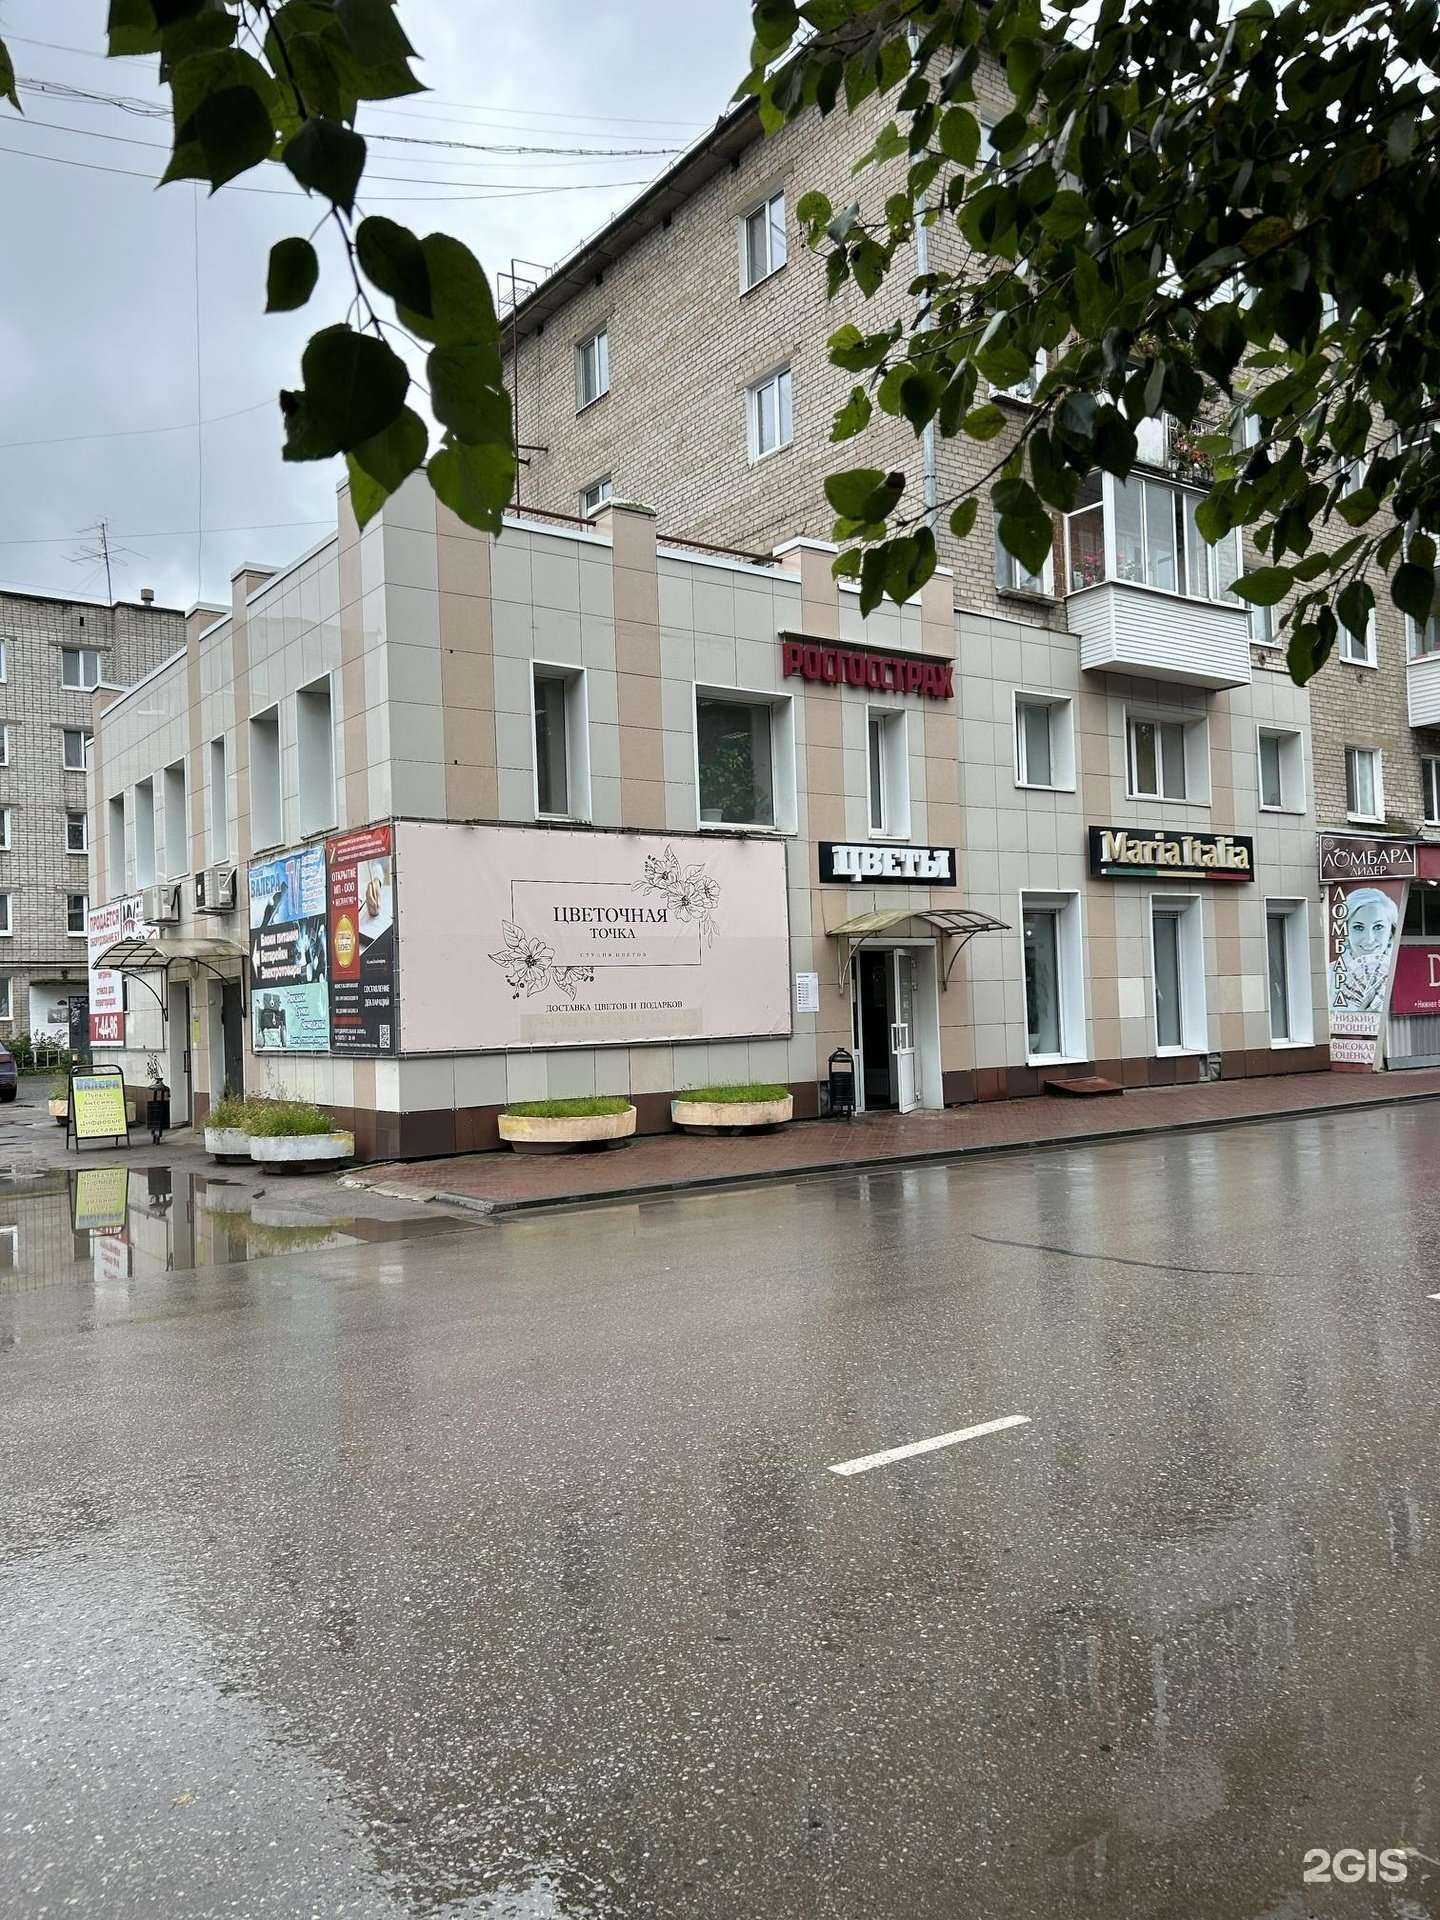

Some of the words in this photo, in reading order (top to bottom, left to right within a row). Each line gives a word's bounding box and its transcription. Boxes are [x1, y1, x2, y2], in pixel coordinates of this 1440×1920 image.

[784, 642, 955, 698] РОСГОССТРАХ
[832, 845, 951, 882] ЦВЕТЫ
[1323, 848, 1412, 868] ЛОМБАРД
[331, 868, 357, 882] ОТКРЫТИЕ
[1350, 865, 1387, 876] ЛИДЕР
[553, 906, 668, 924] ЦВЕТОЧНАЯ
[590, 928, 636, 939] ТОЧКА
[1331, 886, 1349, 1008] ЛОМБАРД
[546, 1003, 591, 1012] ДОСТАВКА
[594, 1002, 628, 1011] ЦВЕТОВ
[630, 1002, 637, 1010] И
[640, 1000, 683, 1009] ПОДАРКОВ
[1333, 1023, 1377, 1032] ПРОЦЕНТ
[1332, 1042, 1375, 1051] ВЫСОКАЯ
[1335, 1051, 1371, 1060] ОЦЕНКА
